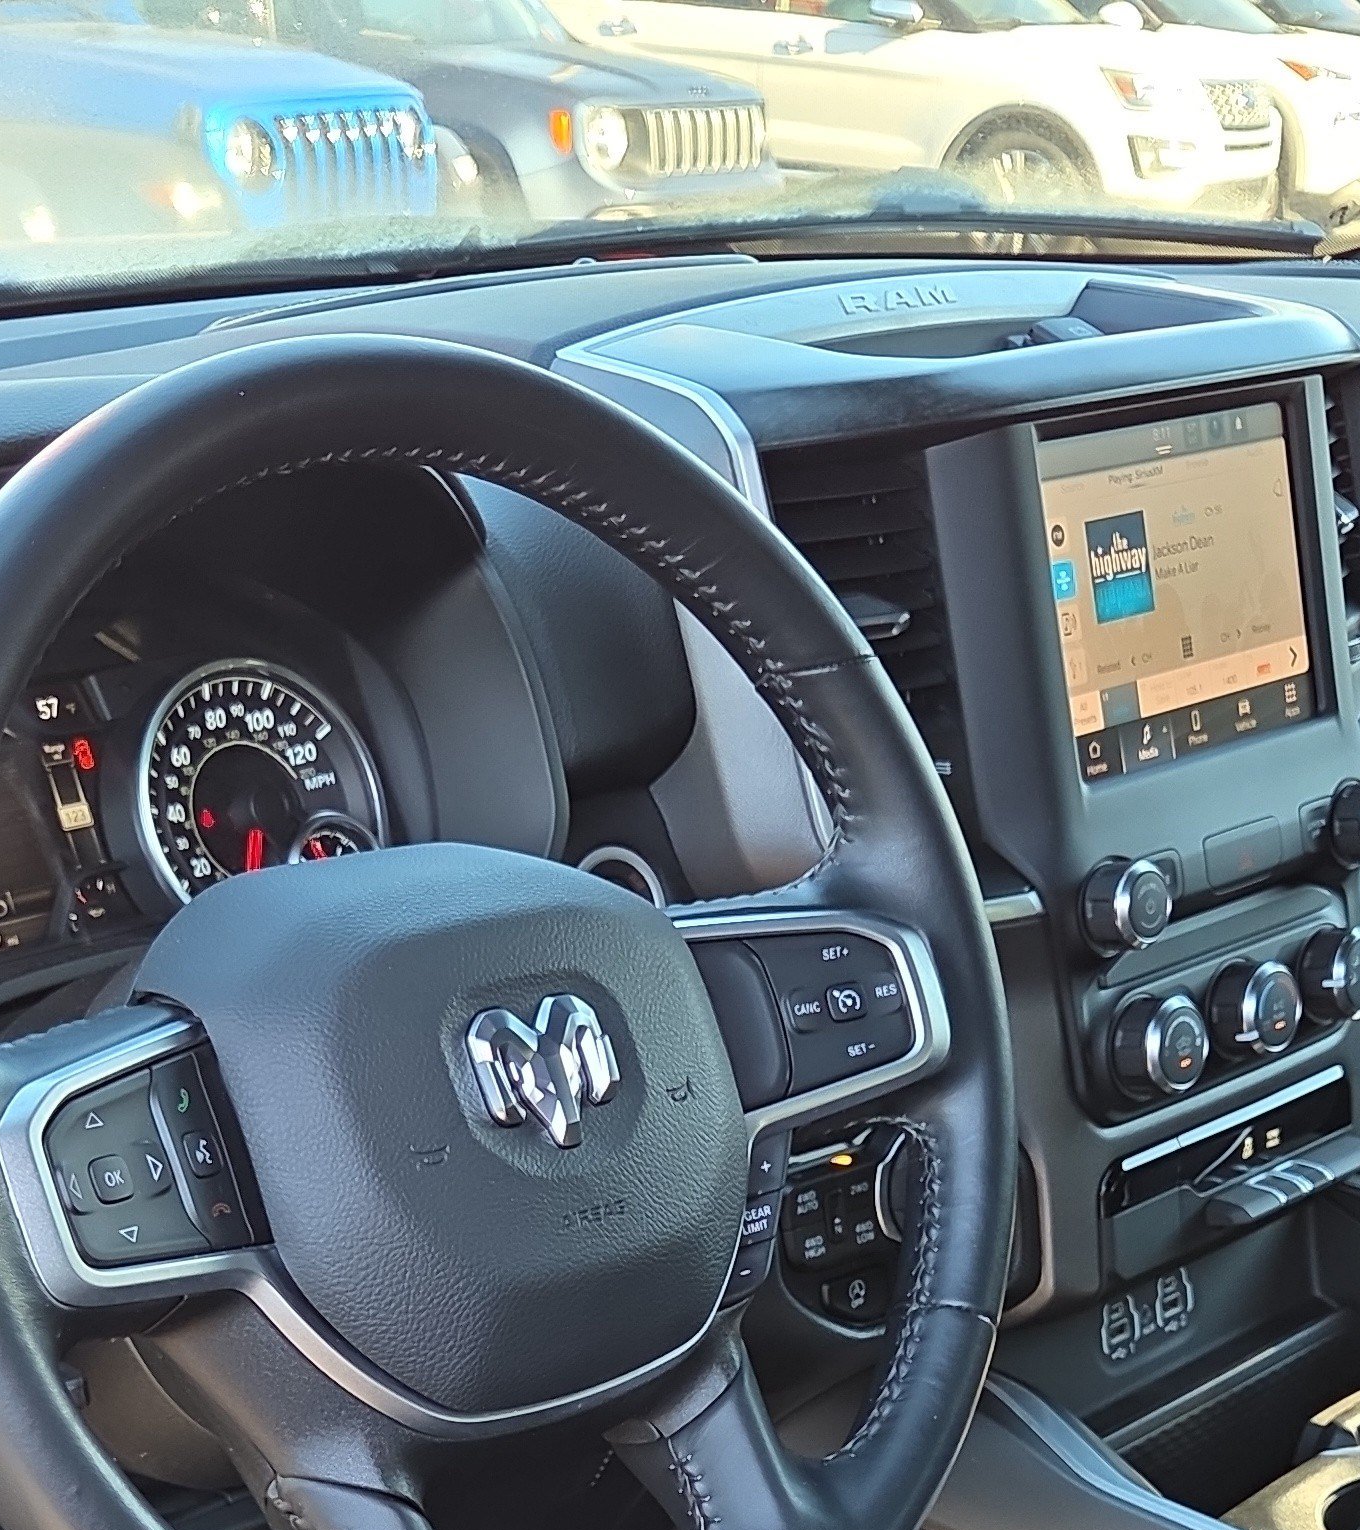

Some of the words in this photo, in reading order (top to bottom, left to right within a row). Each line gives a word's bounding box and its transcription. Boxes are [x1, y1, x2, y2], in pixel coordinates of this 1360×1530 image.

[837, 282, 957, 316] RAM
[1112, 531, 1129, 551] the
[1152, 539, 1189, 561] Jackson
[1189, 534, 1215, 551] Dean
[1090, 545, 1147, 581] highway
[34, 695, 59, 720] 57
[204, 706, 227, 731] 80
[243, 706, 275, 733] 100
[170, 744, 191, 768] 60
[285, 740, 317, 767] 120
[303, 771, 337, 792] MPH
[65, 805, 89, 826] 123
[166, 801, 186, 824] 40
[190, 855, 212, 878] 20
[875, 983, 897, 999] RES
[104, 1169, 125, 1188] OK
[744, 1204, 772, 1222] GEAR
[742, 1217, 768, 1236] LIMIT
